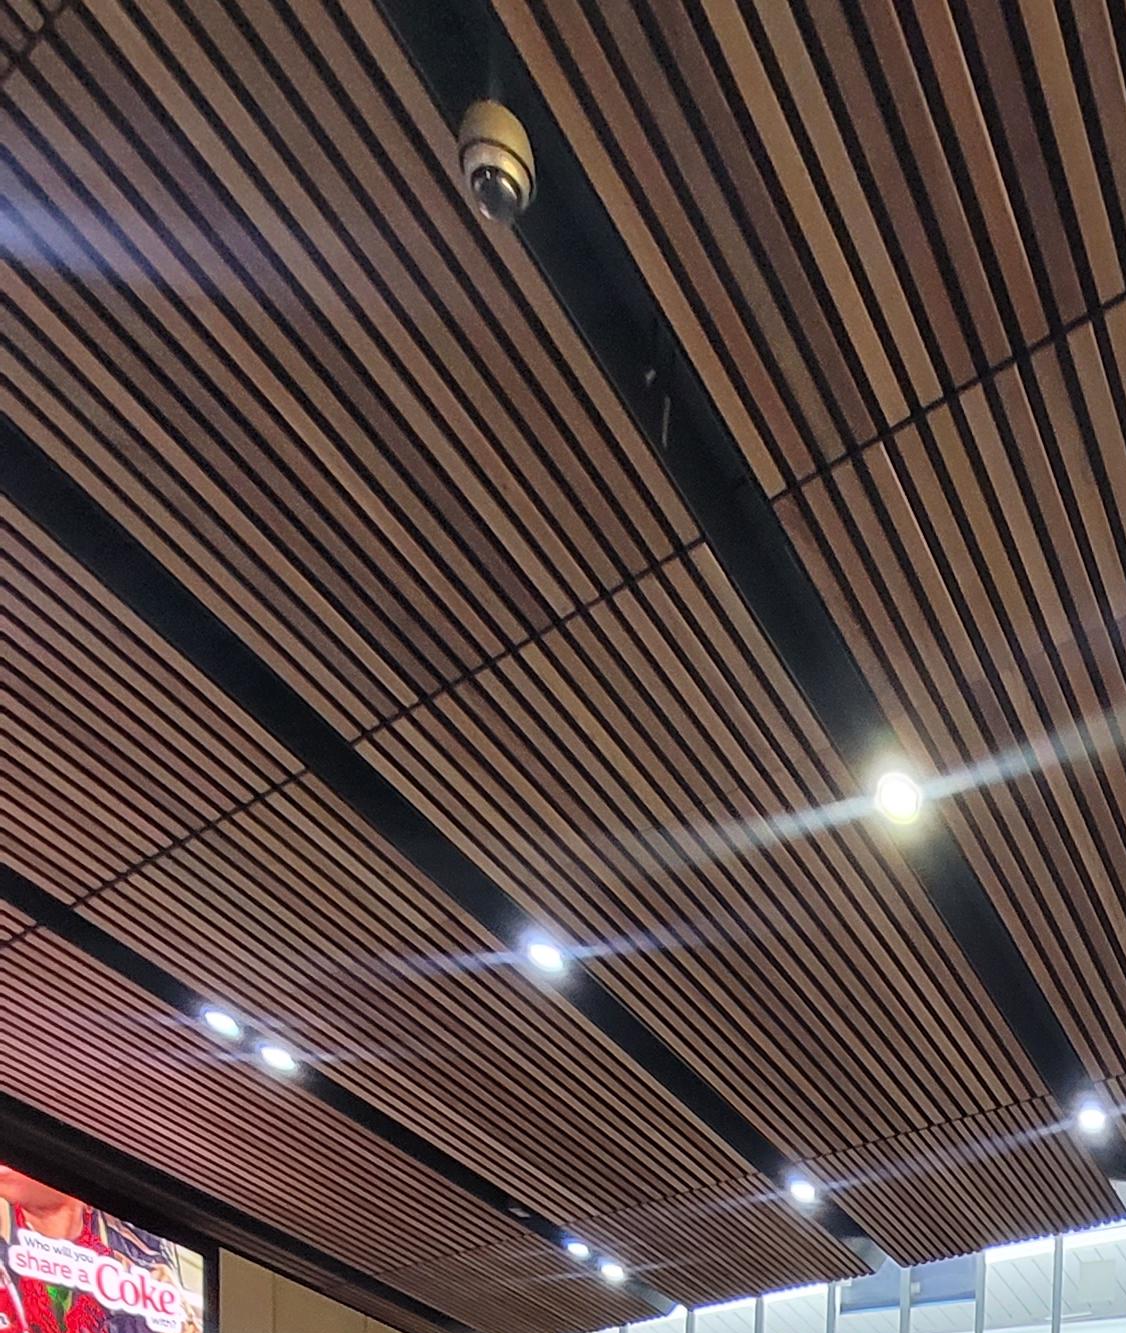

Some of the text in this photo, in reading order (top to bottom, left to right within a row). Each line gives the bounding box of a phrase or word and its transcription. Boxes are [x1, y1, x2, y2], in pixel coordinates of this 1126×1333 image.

[23, 1235, 94, 1264] Who will you
[15, 1250, 176, 1316] share a Coke
